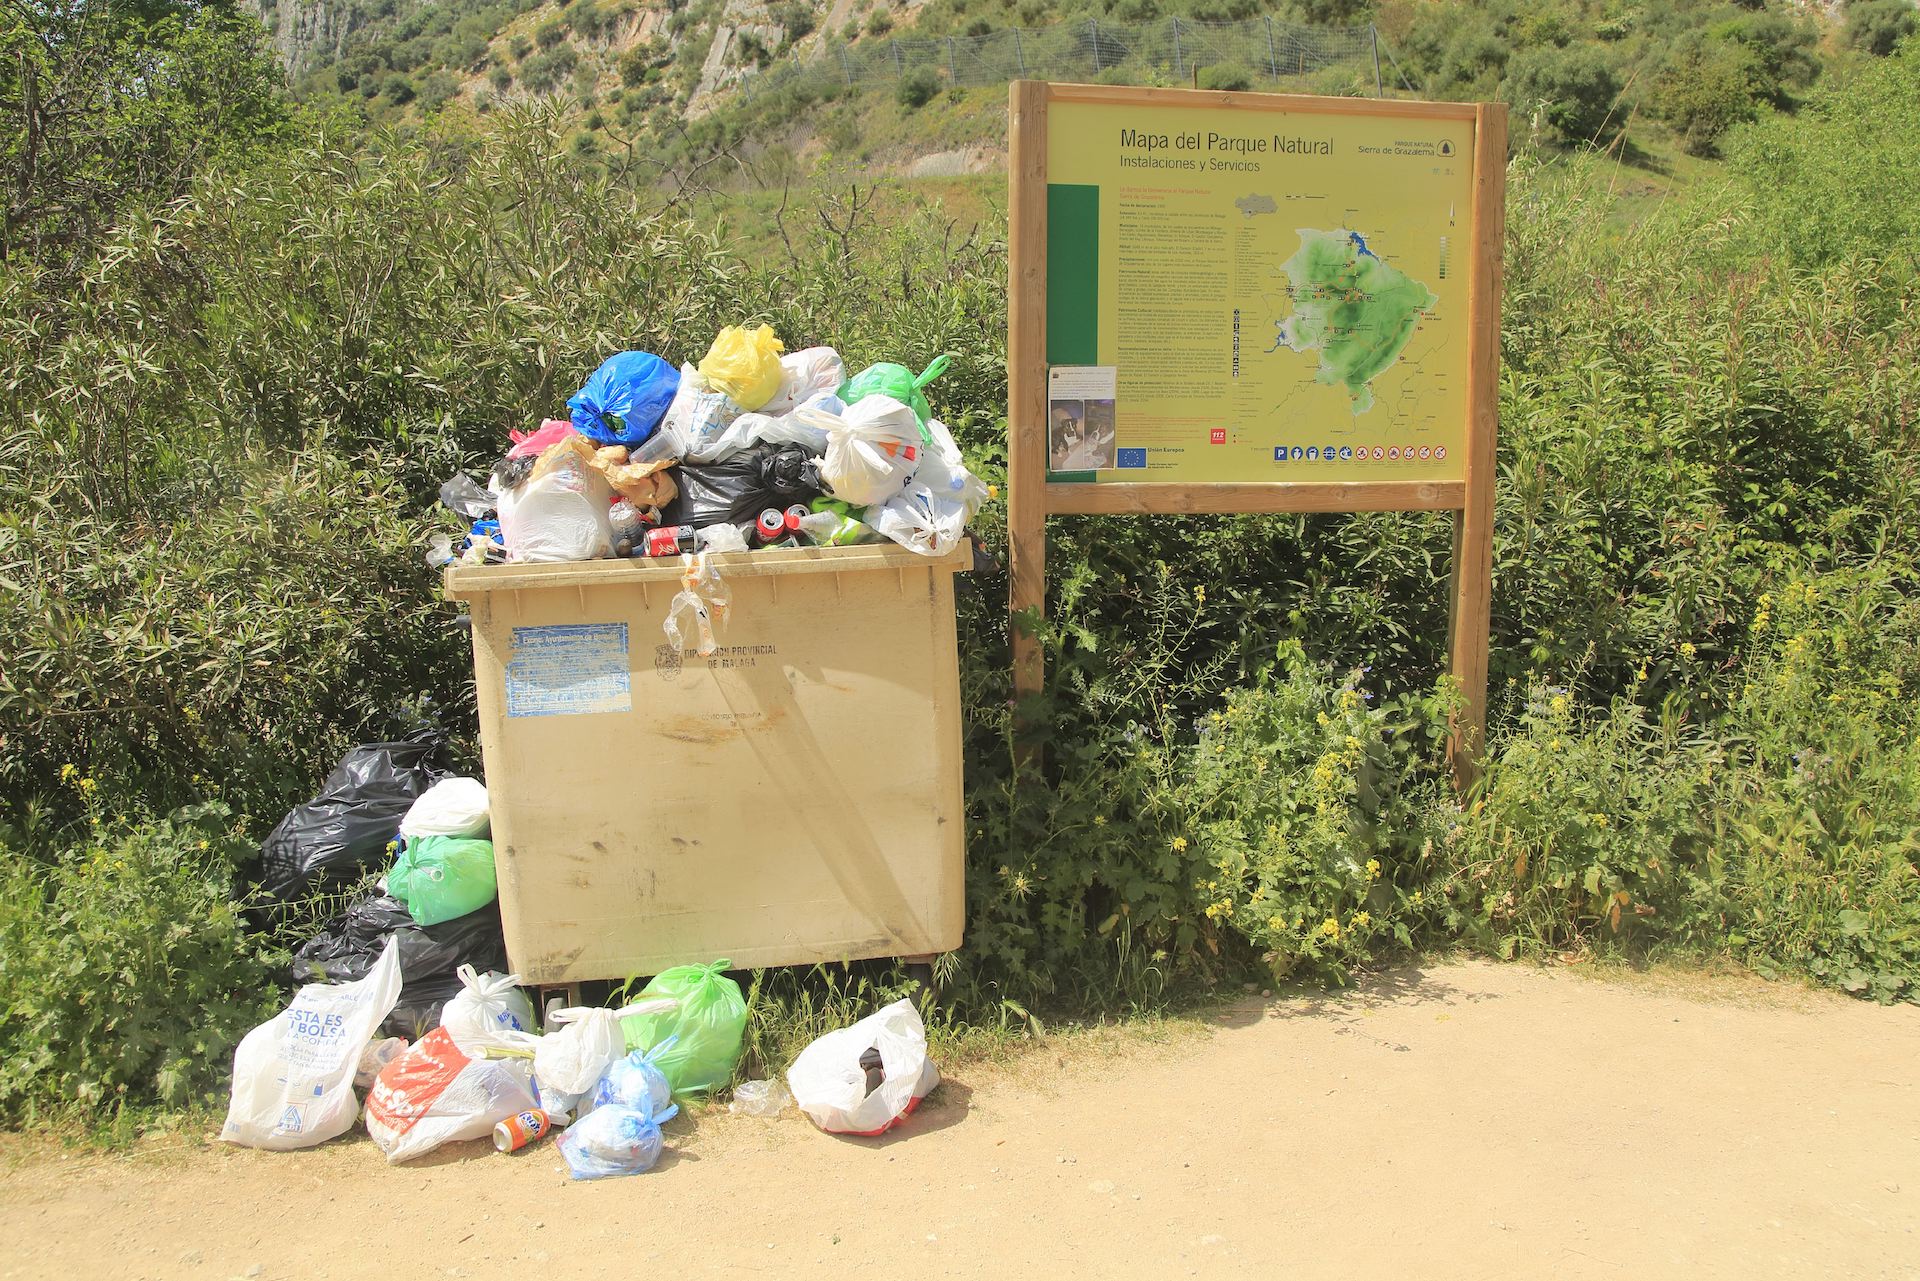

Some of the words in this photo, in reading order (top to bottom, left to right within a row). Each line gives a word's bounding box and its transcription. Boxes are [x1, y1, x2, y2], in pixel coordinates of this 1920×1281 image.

[1121, 129, 1169, 151] Mapa
[1175, 132, 1201, 150] del
[1208, 132, 1267, 155] Parque
[1274, 135, 1334, 155] Natural
[1358, 145, 1380, 154] Sierra
[1394, 147, 1435, 156] Grazalema
[1120, 155, 1196, 169] Instalaciones
[1199, 160, 1206, 171] y
[1209, 157, 1261, 172] Servicios
[732, 645, 777, 656] PROVINCIAL
[287, 1008, 321, 1025] ESTA
[325, 1013, 344, 1027] ES
[298, 1022, 346, 1039] BOLSA
